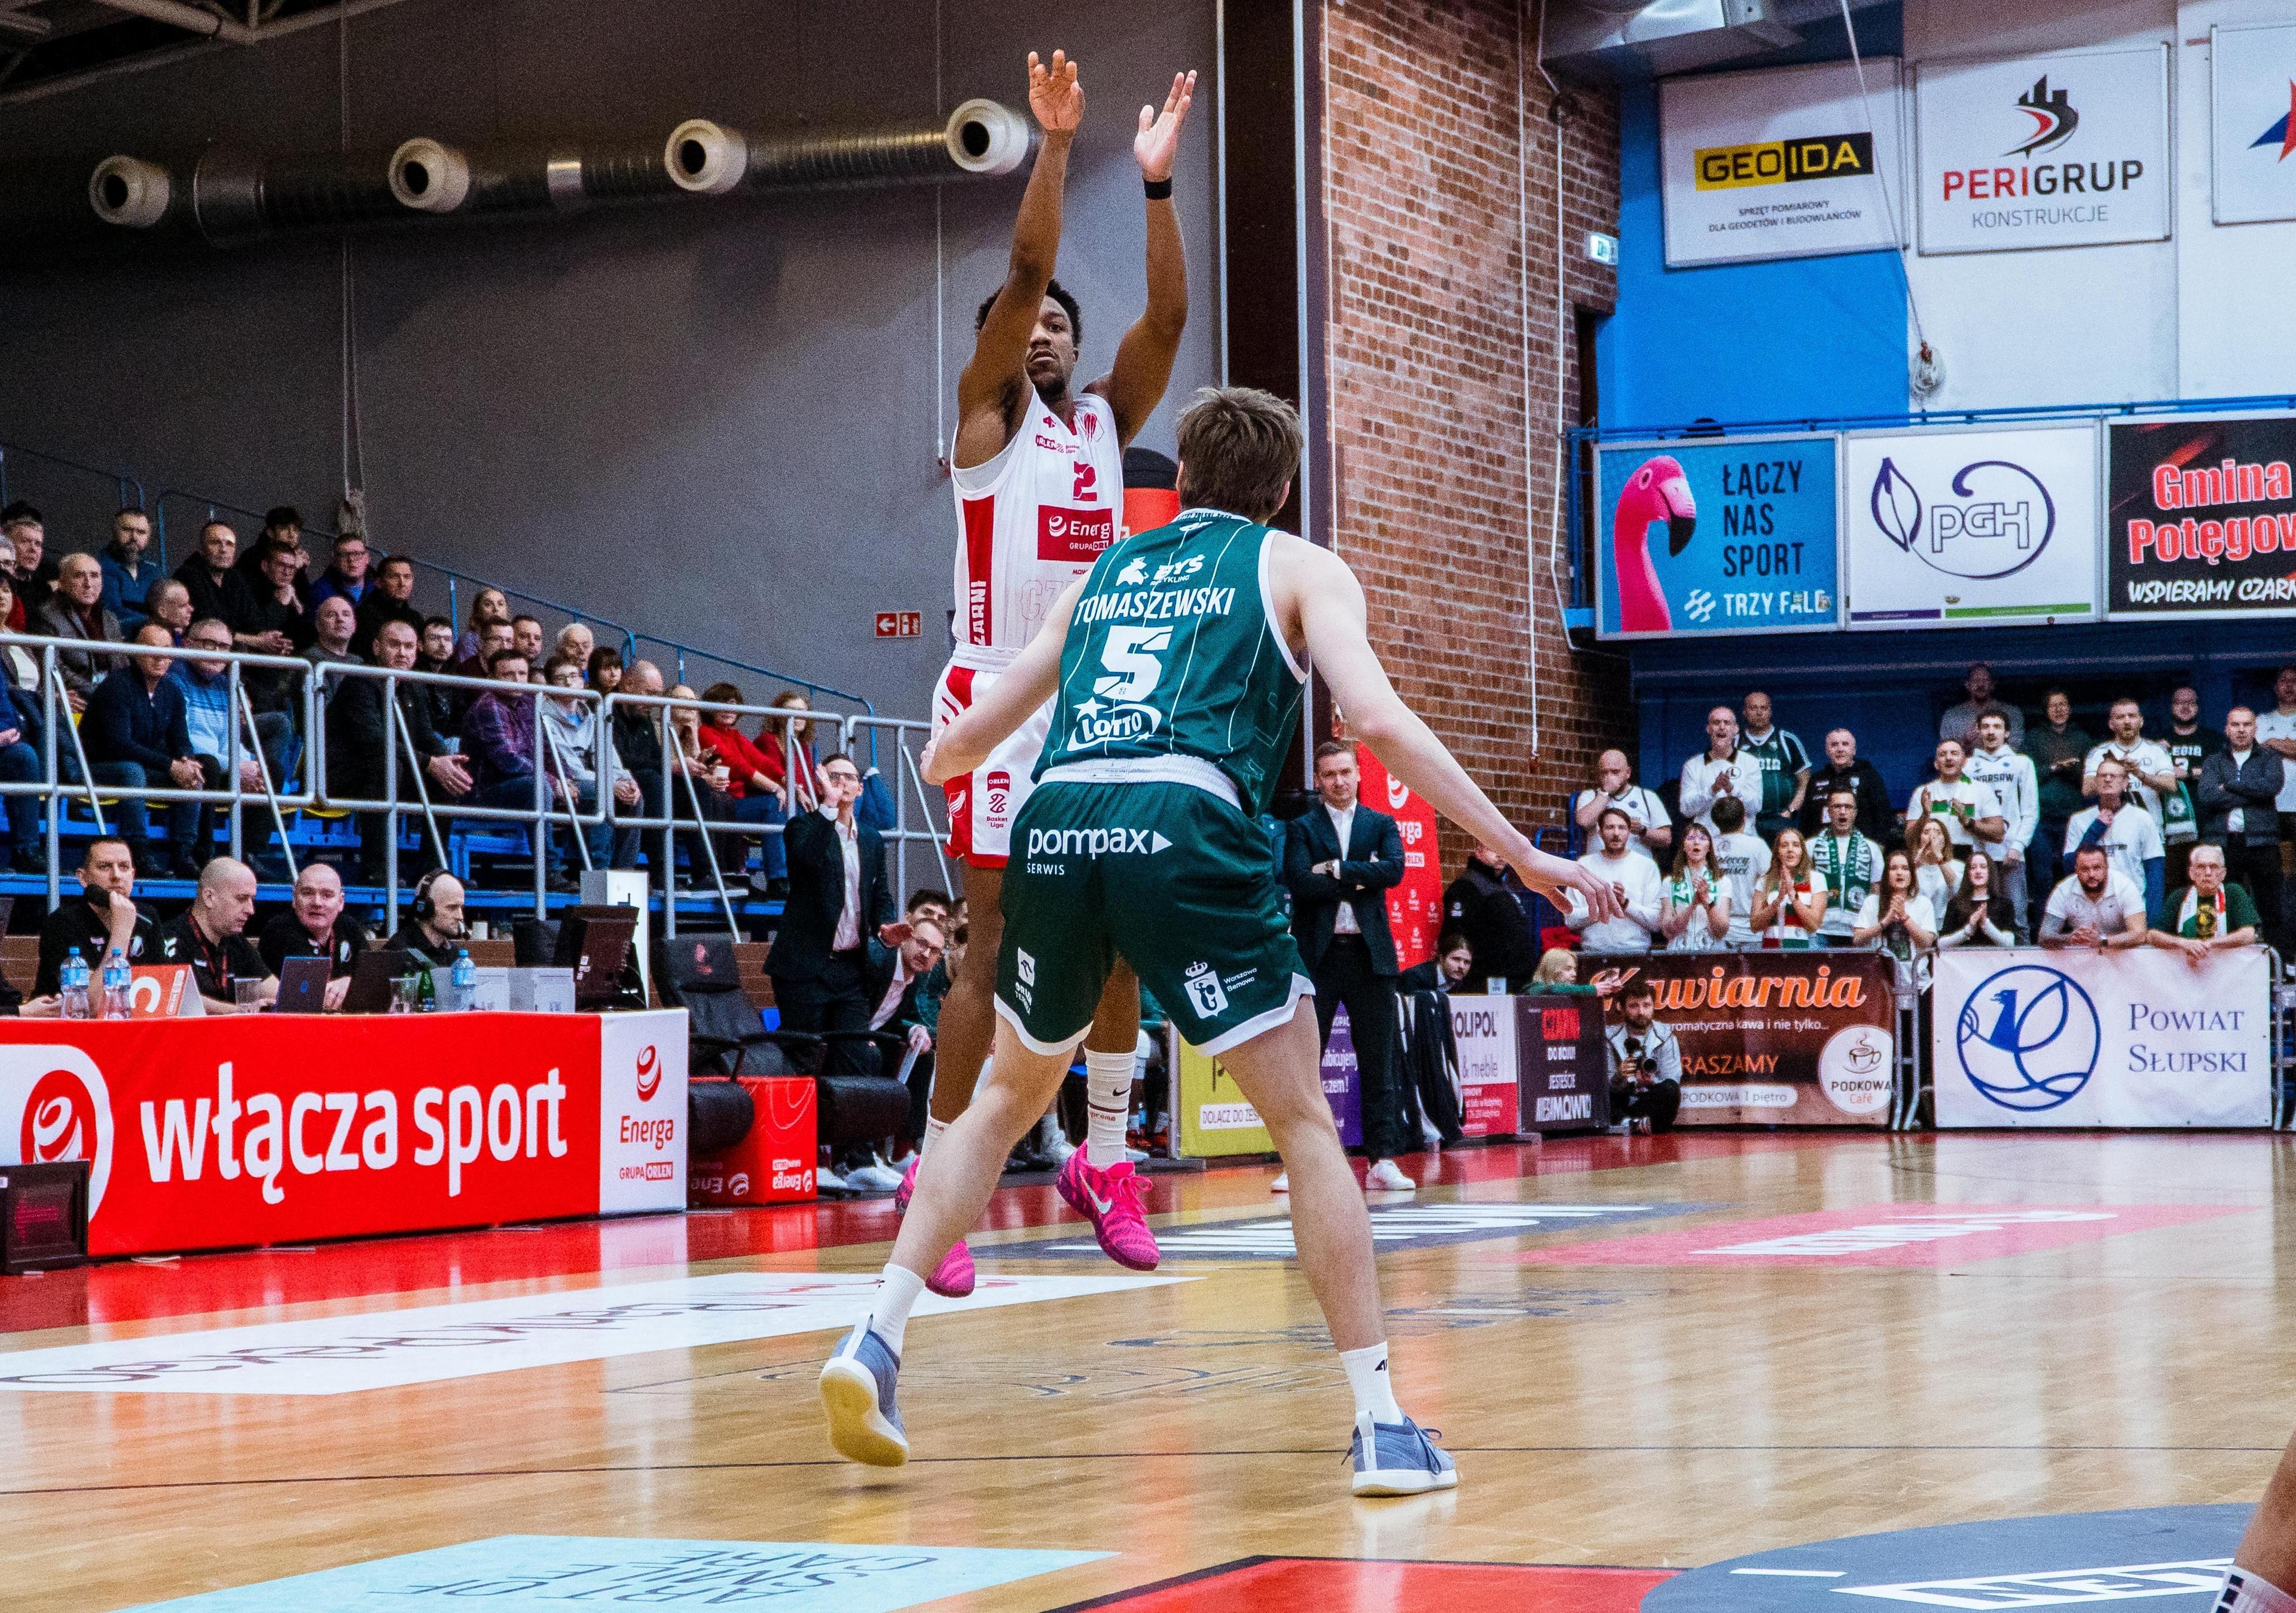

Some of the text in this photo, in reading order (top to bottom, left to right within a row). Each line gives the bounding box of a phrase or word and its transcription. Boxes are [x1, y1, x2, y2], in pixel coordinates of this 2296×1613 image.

[1703, 141, 1860, 181] GEOIDA
[1943, 160, 2143, 201] PERIGRUP
[1973, 206, 2109, 228] KONSTRUKCJE
[1073, 462, 1098, 502] 2
[1723, 460, 1803, 499] ŁĄCZY
[2153, 459, 2292, 510] Gmina
[1724, 503, 1773, 536] NAS
[1723, 542, 1805, 577] SPORT
[1074, 588, 1236, 626] TOMASZEWSKI
[1723, 592, 1773, 616] TRZY
[2128, 578, 2236, 603] WSPIERAMY
[1093, 625, 1174, 701] 5
[1082, 711, 1141, 742] LOTTO
[1027, 827, 1149, 860] pompax
[1027, 863, 1065, 875] SERWIS
[1223, 968, 1257, 984] Warszawa
[1227, 977, 1254, 992] Bemowo
[1590, 966, 1866, 1011] Kwiarnia
[1668, 1019, 1734, 1034] romatyczna
[1736, 1019, 1764, 1030] kawa
[1773, 1019, 1791, 1030] nie
[1752, 1092, 1788, 1105] piętro
[1831, 1081, 1892, 1092] PODKOWA
[139, 1061, 569, 1205] włącza sport
[619, 1116, 674, 1150] Energa
[619, 1166, 645, 1181] GRUPA
[646, 1163, 673, 1180] ORLEN
